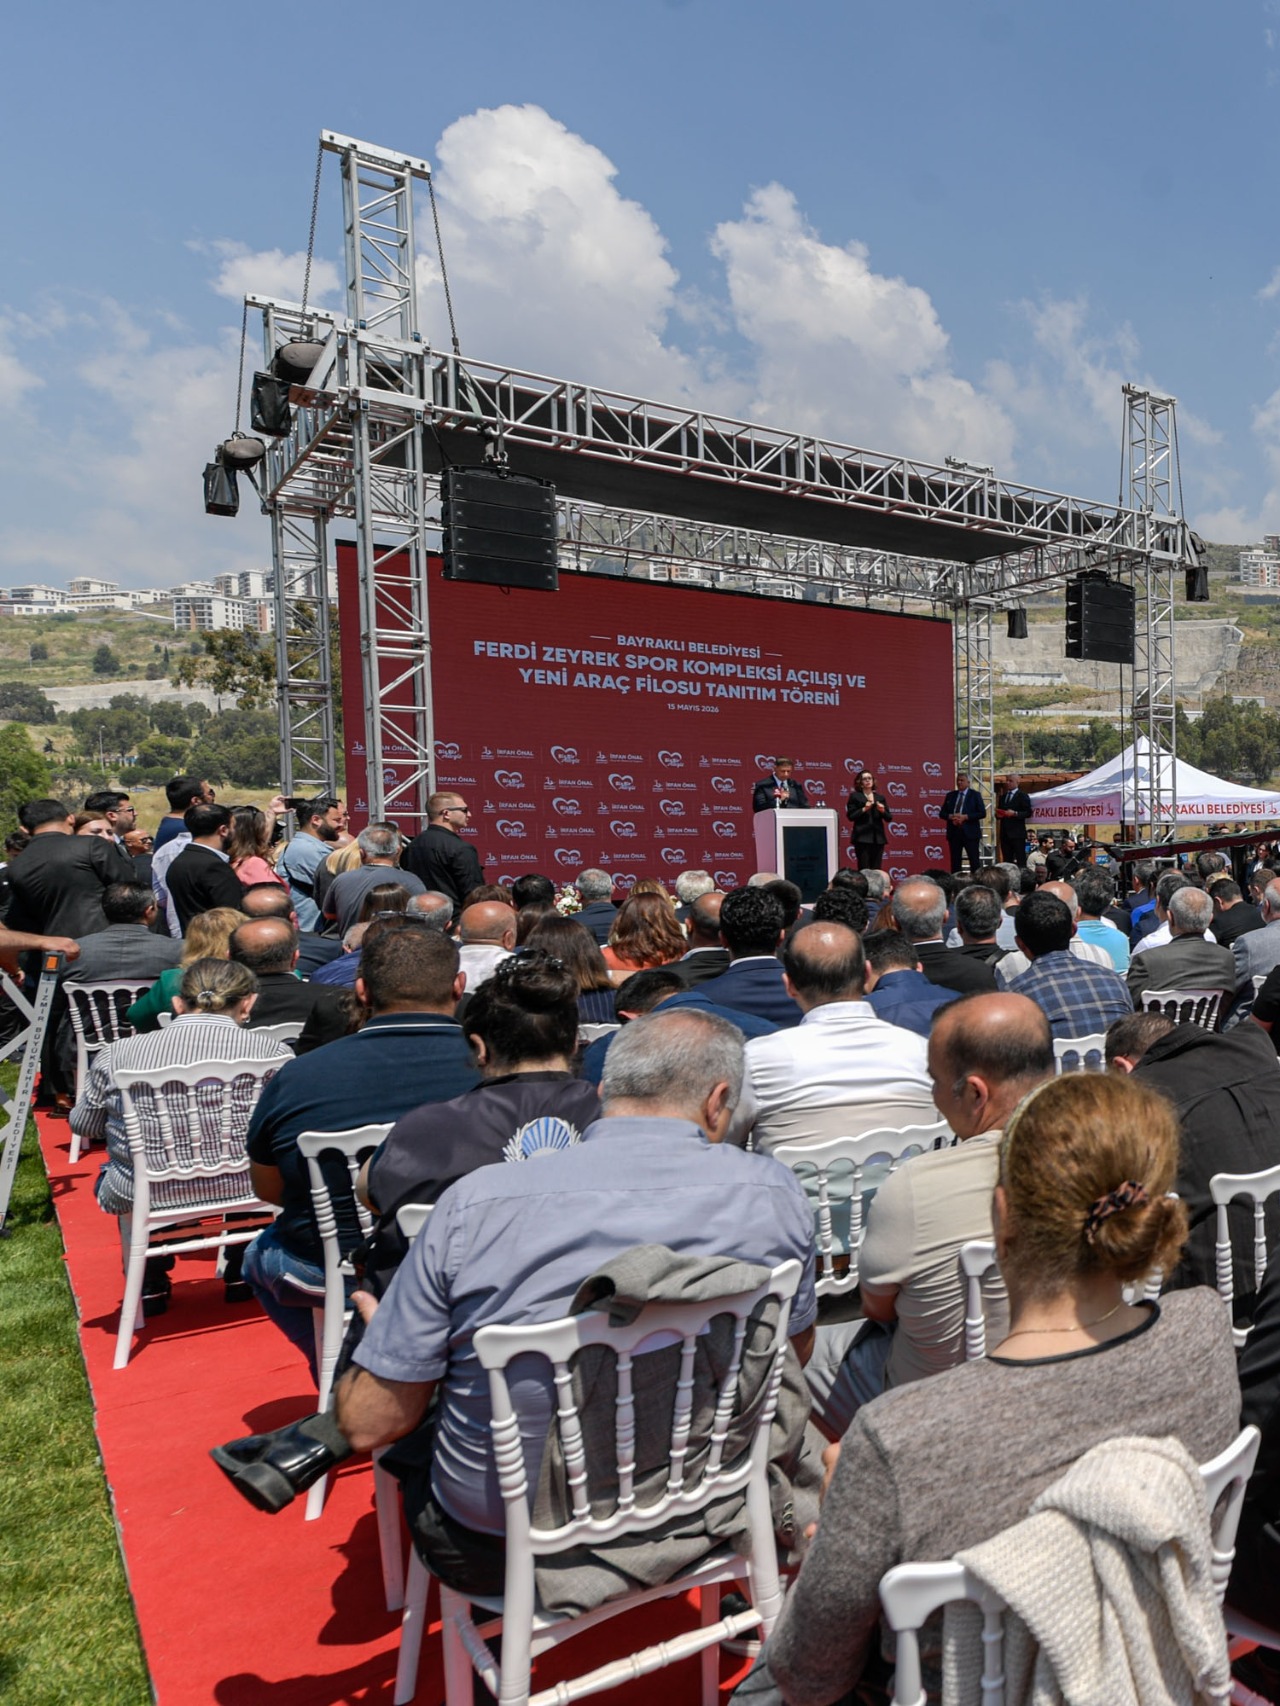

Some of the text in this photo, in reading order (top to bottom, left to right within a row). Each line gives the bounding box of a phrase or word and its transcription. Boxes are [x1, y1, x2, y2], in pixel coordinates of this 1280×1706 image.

[617, 634, 760, 658] BAYRAKLI BELEDİYESİ
[474, 640, 866, 689] FERDİ ZEYREK SPOR KOMPLEKSİ AÇILIŞI VE
[519, 667, 840, 706] YENİ ARAÇ FİLOSU TANITIM TÖRENİ
[677, 704, 700, 712] MAYIS
[701, 705, 719, 713] 2026
[1030, 802, 1104, 818] YRAKLI BELEDİYESİ
[1207, 801, 1266, 814] BELEDİYESİ
